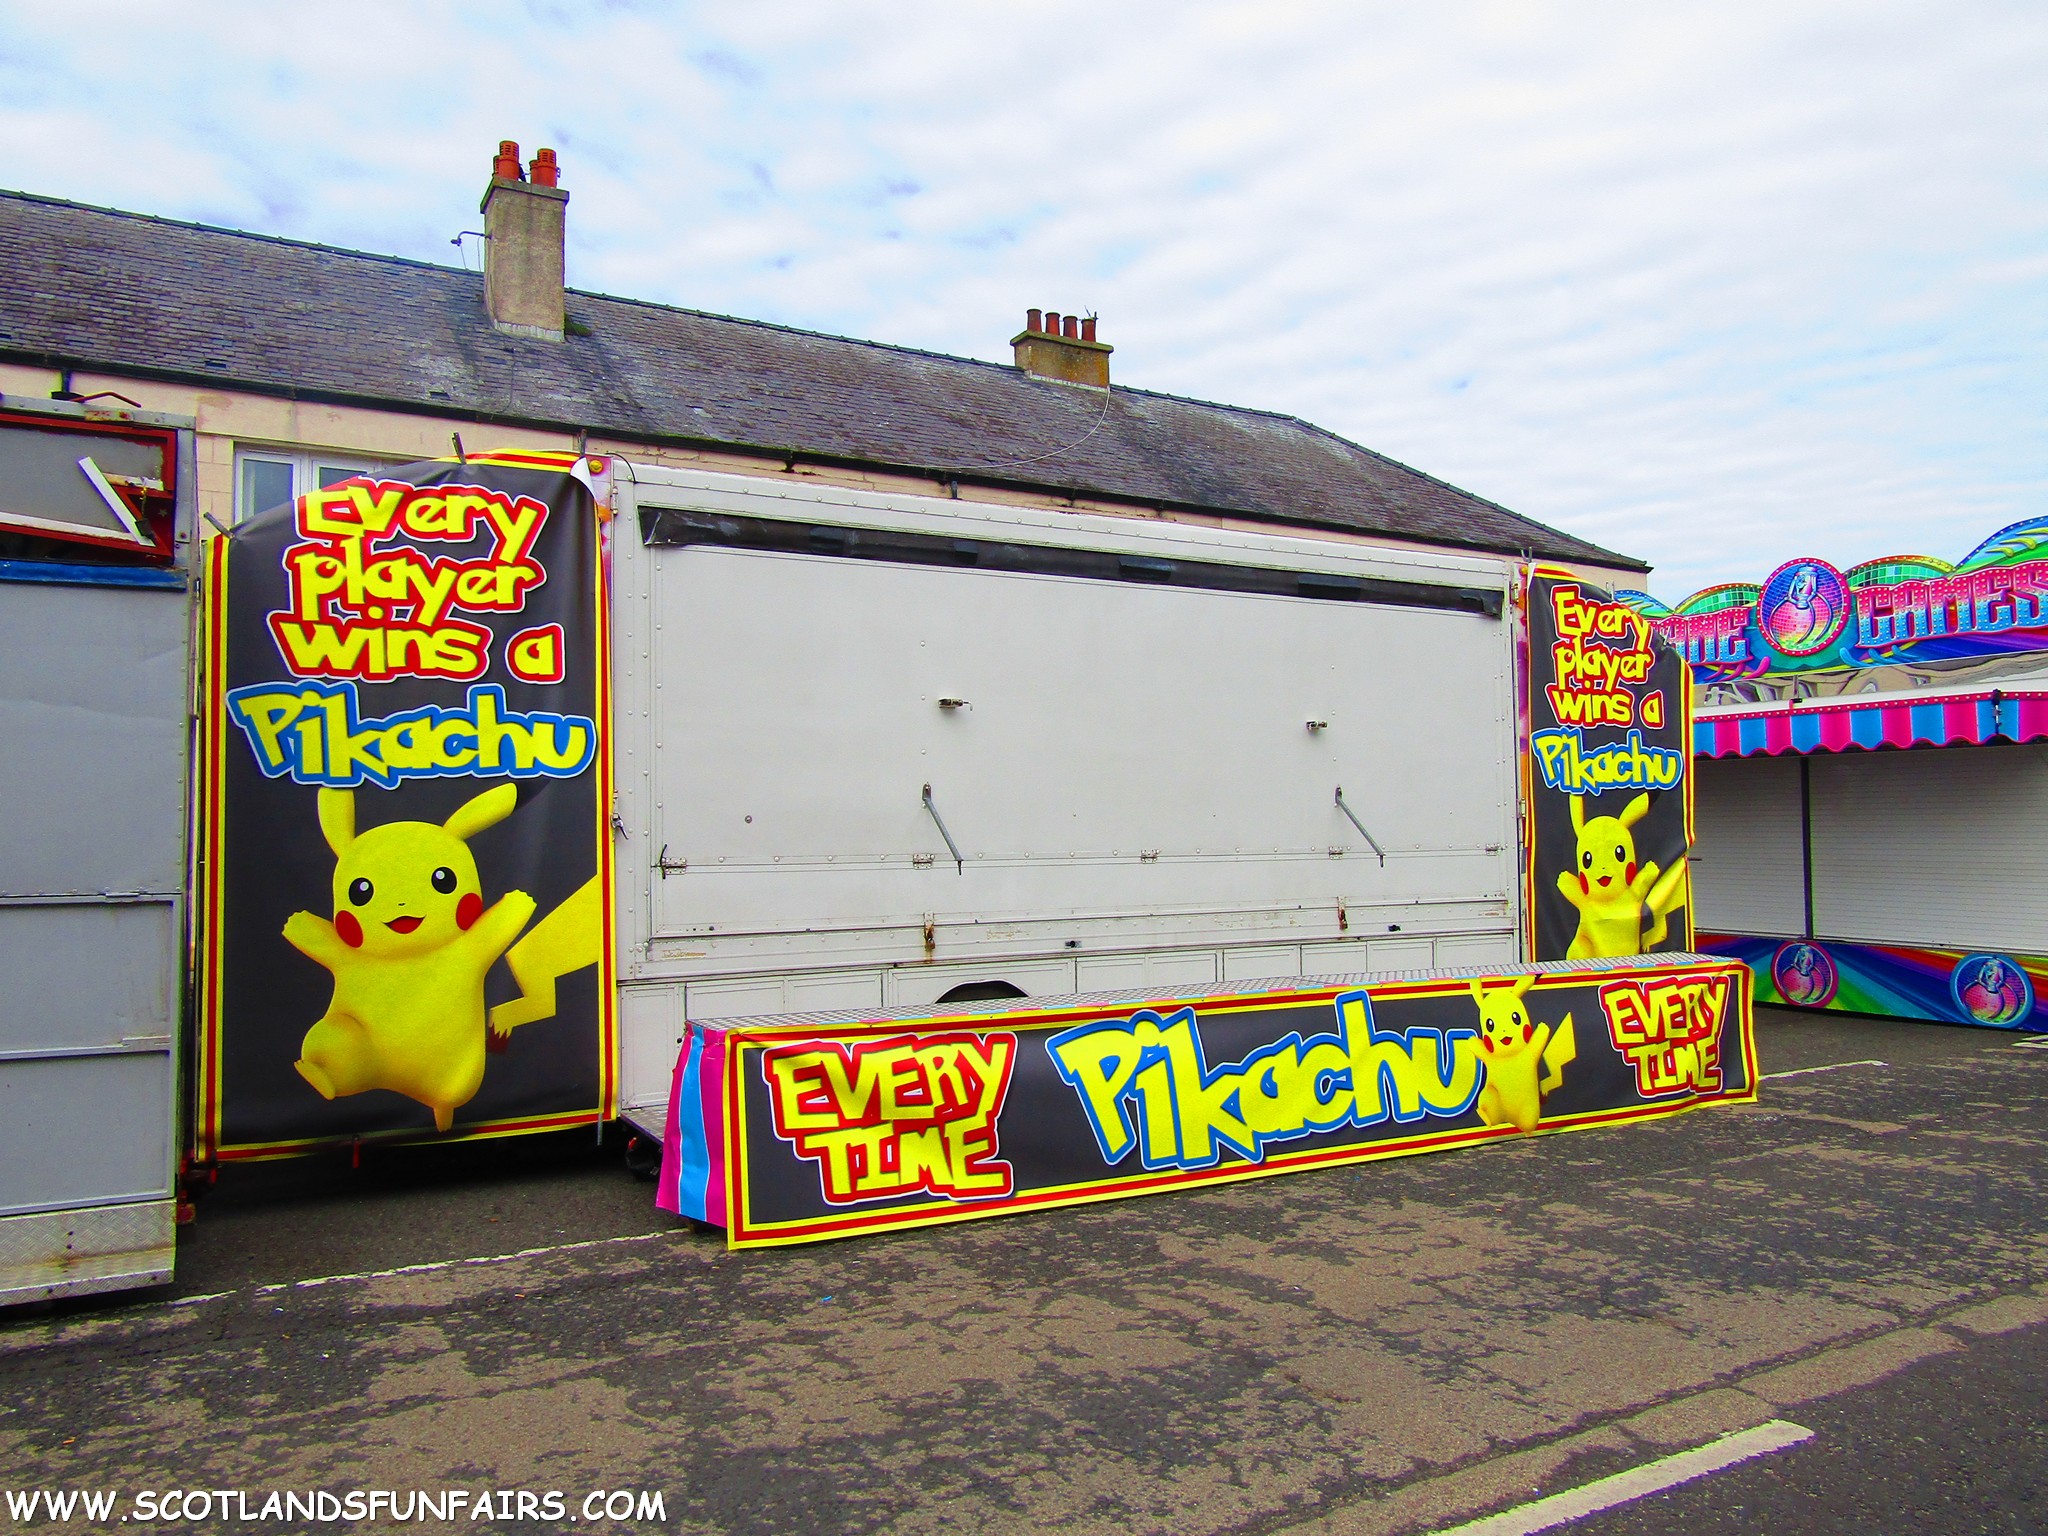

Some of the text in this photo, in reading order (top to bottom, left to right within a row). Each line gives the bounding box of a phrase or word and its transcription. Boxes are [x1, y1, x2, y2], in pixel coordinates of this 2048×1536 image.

[303, 487, 539, 563] Every
[294, 535, 535, 622] player
[1852, 560, 2048, 649] GAMES
[282, 607, 556, 675] wins a
[1556, 590, 1648, 652] Every
[1555, 634, 1652, 693] player
[236, 690, 588, 780] Pikachu
[1551, 679, 1662, 724] wins a
[1534, 733, 1677, 789] Pikachu
[1603, 975, 1726, 1043] EVERY
[771, 1040, 1010, 1128] EVERY
[1053, 994, 1481, 1161] Pikachu
[1626, 1038, 1721, 1092] TIME
[804, 1119, 1004, 1195] TIME
